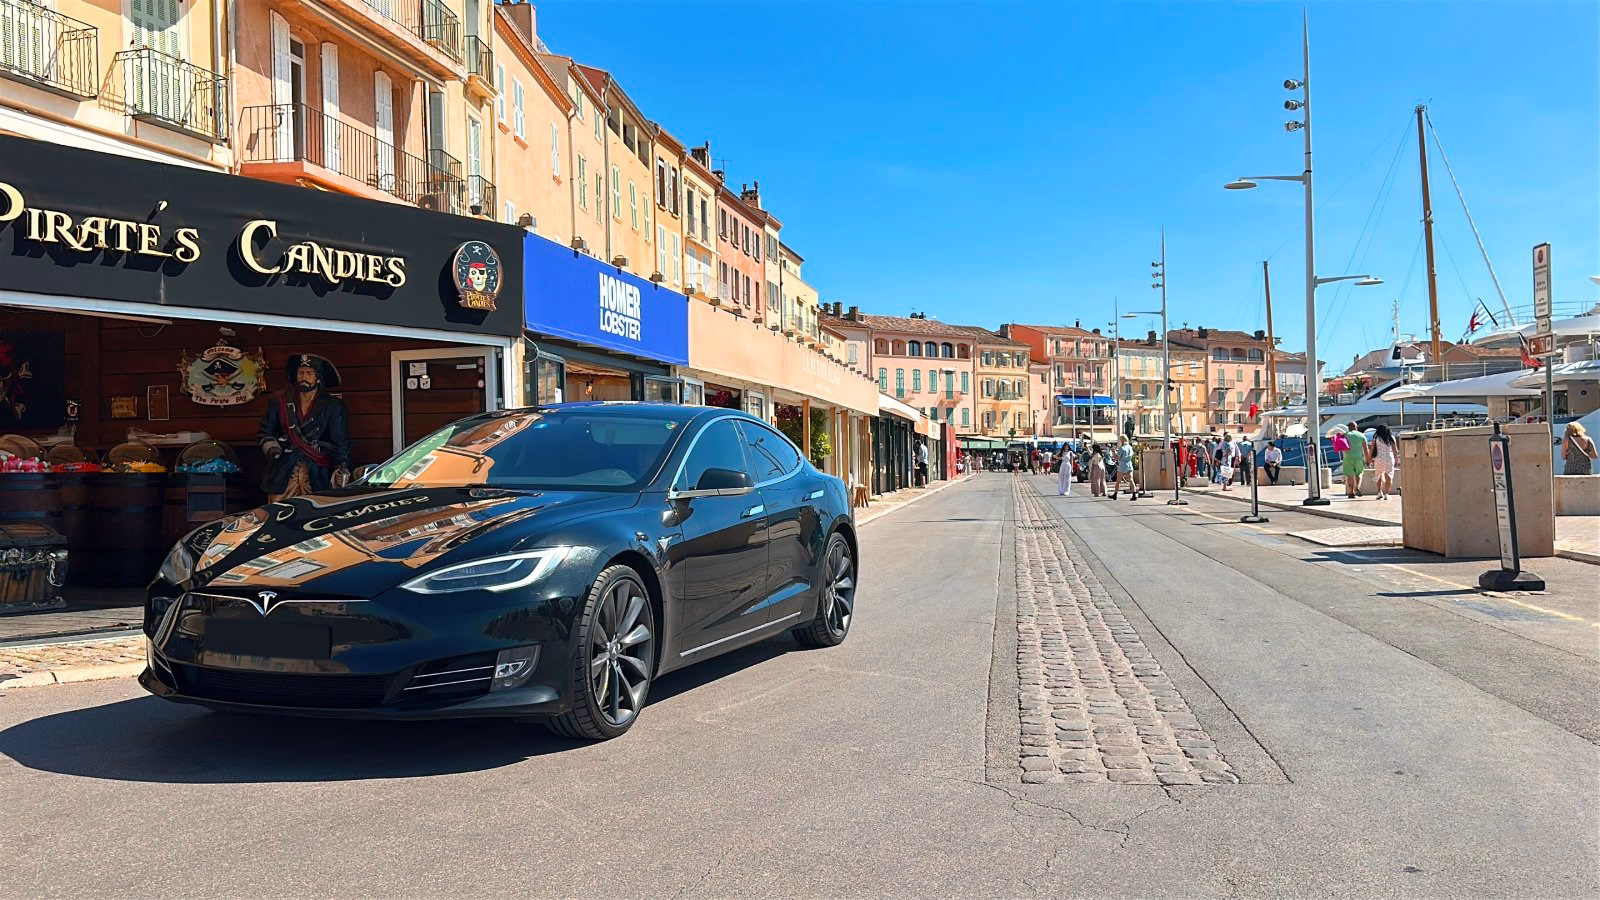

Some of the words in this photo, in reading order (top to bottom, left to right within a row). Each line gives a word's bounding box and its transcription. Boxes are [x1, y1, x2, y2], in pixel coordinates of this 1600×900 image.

[238, 219, 406, 288] CANDIES
[599, 271, 641, 321] HOMER
[599, 307, 641, 342] LOBSTER
